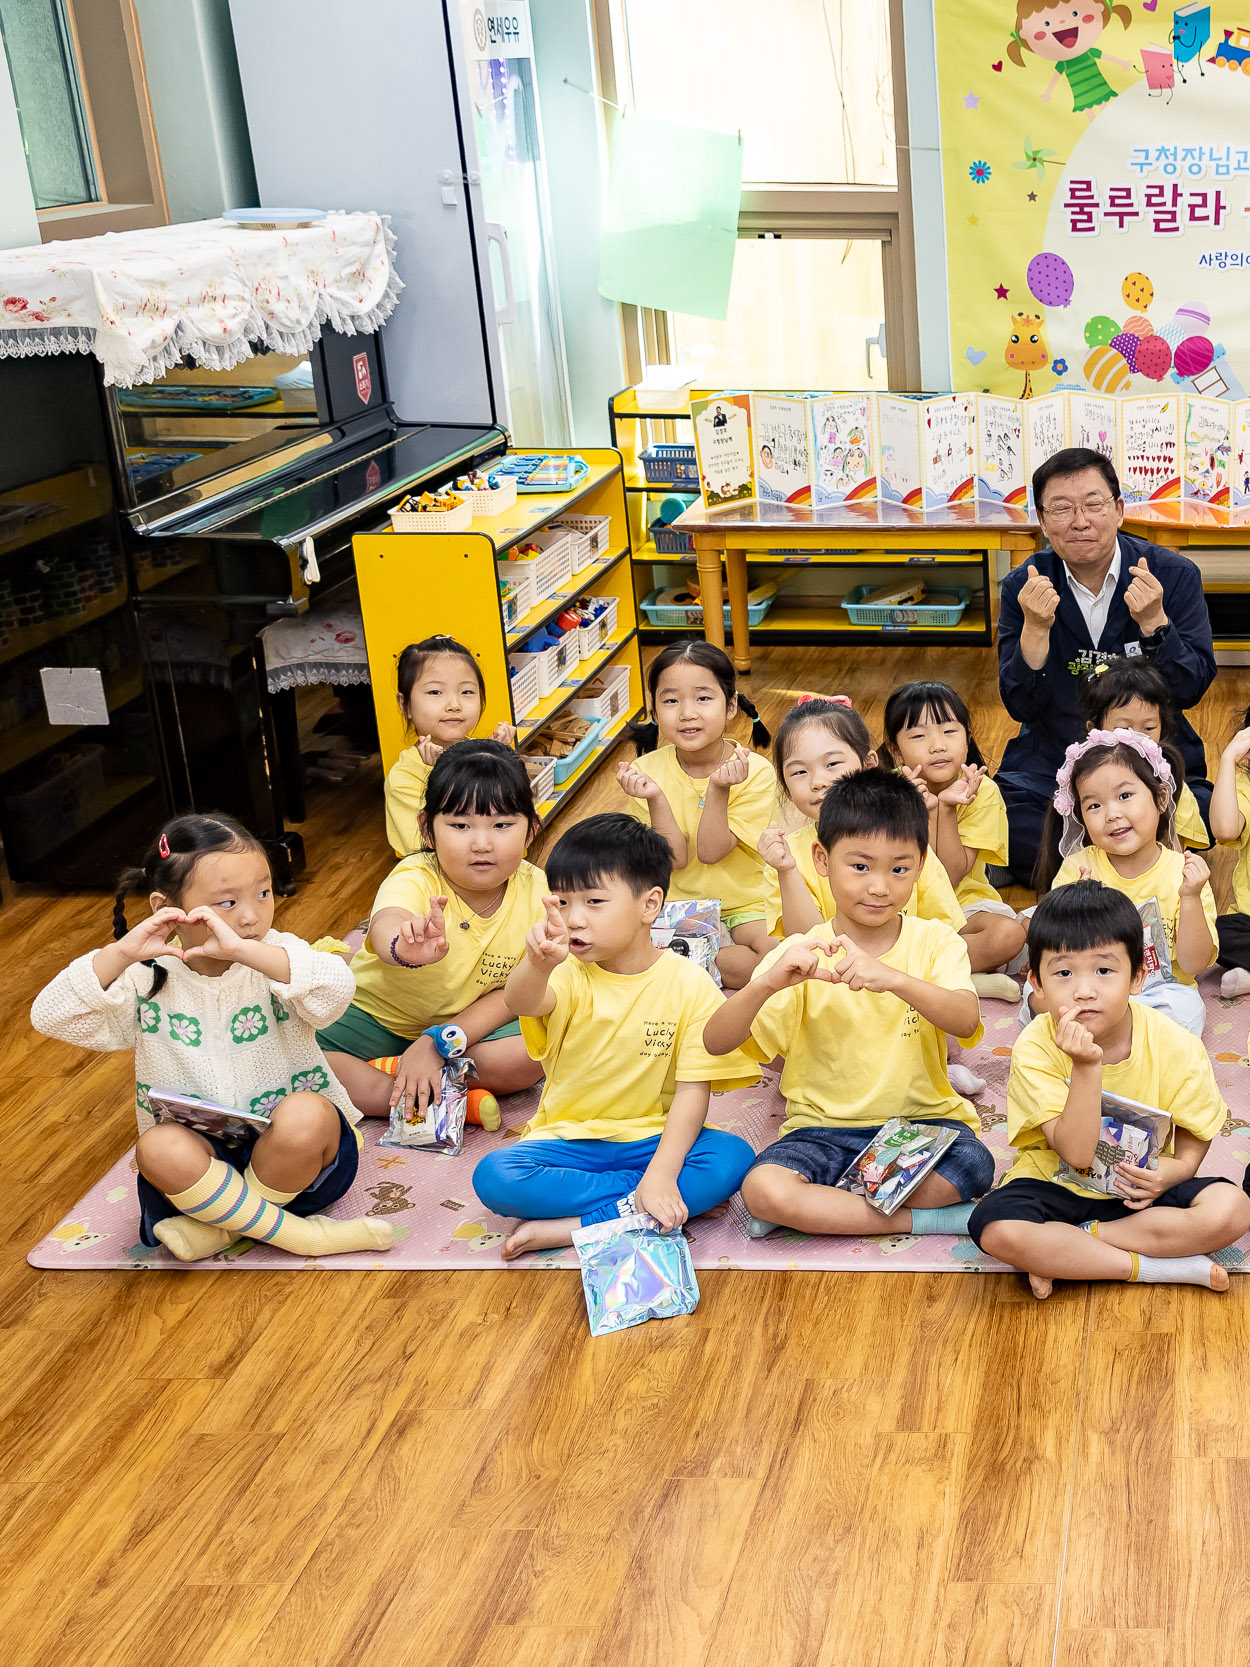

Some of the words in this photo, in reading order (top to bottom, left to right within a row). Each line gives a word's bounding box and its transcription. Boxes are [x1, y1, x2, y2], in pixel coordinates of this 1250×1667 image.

[487, 16, 520, 43] 연세우유
[1064, 179, 1227, 233] 룰루랄라
[480, 968, 511, 978] Vicky
[481, 958, 515, 971] Lucky
